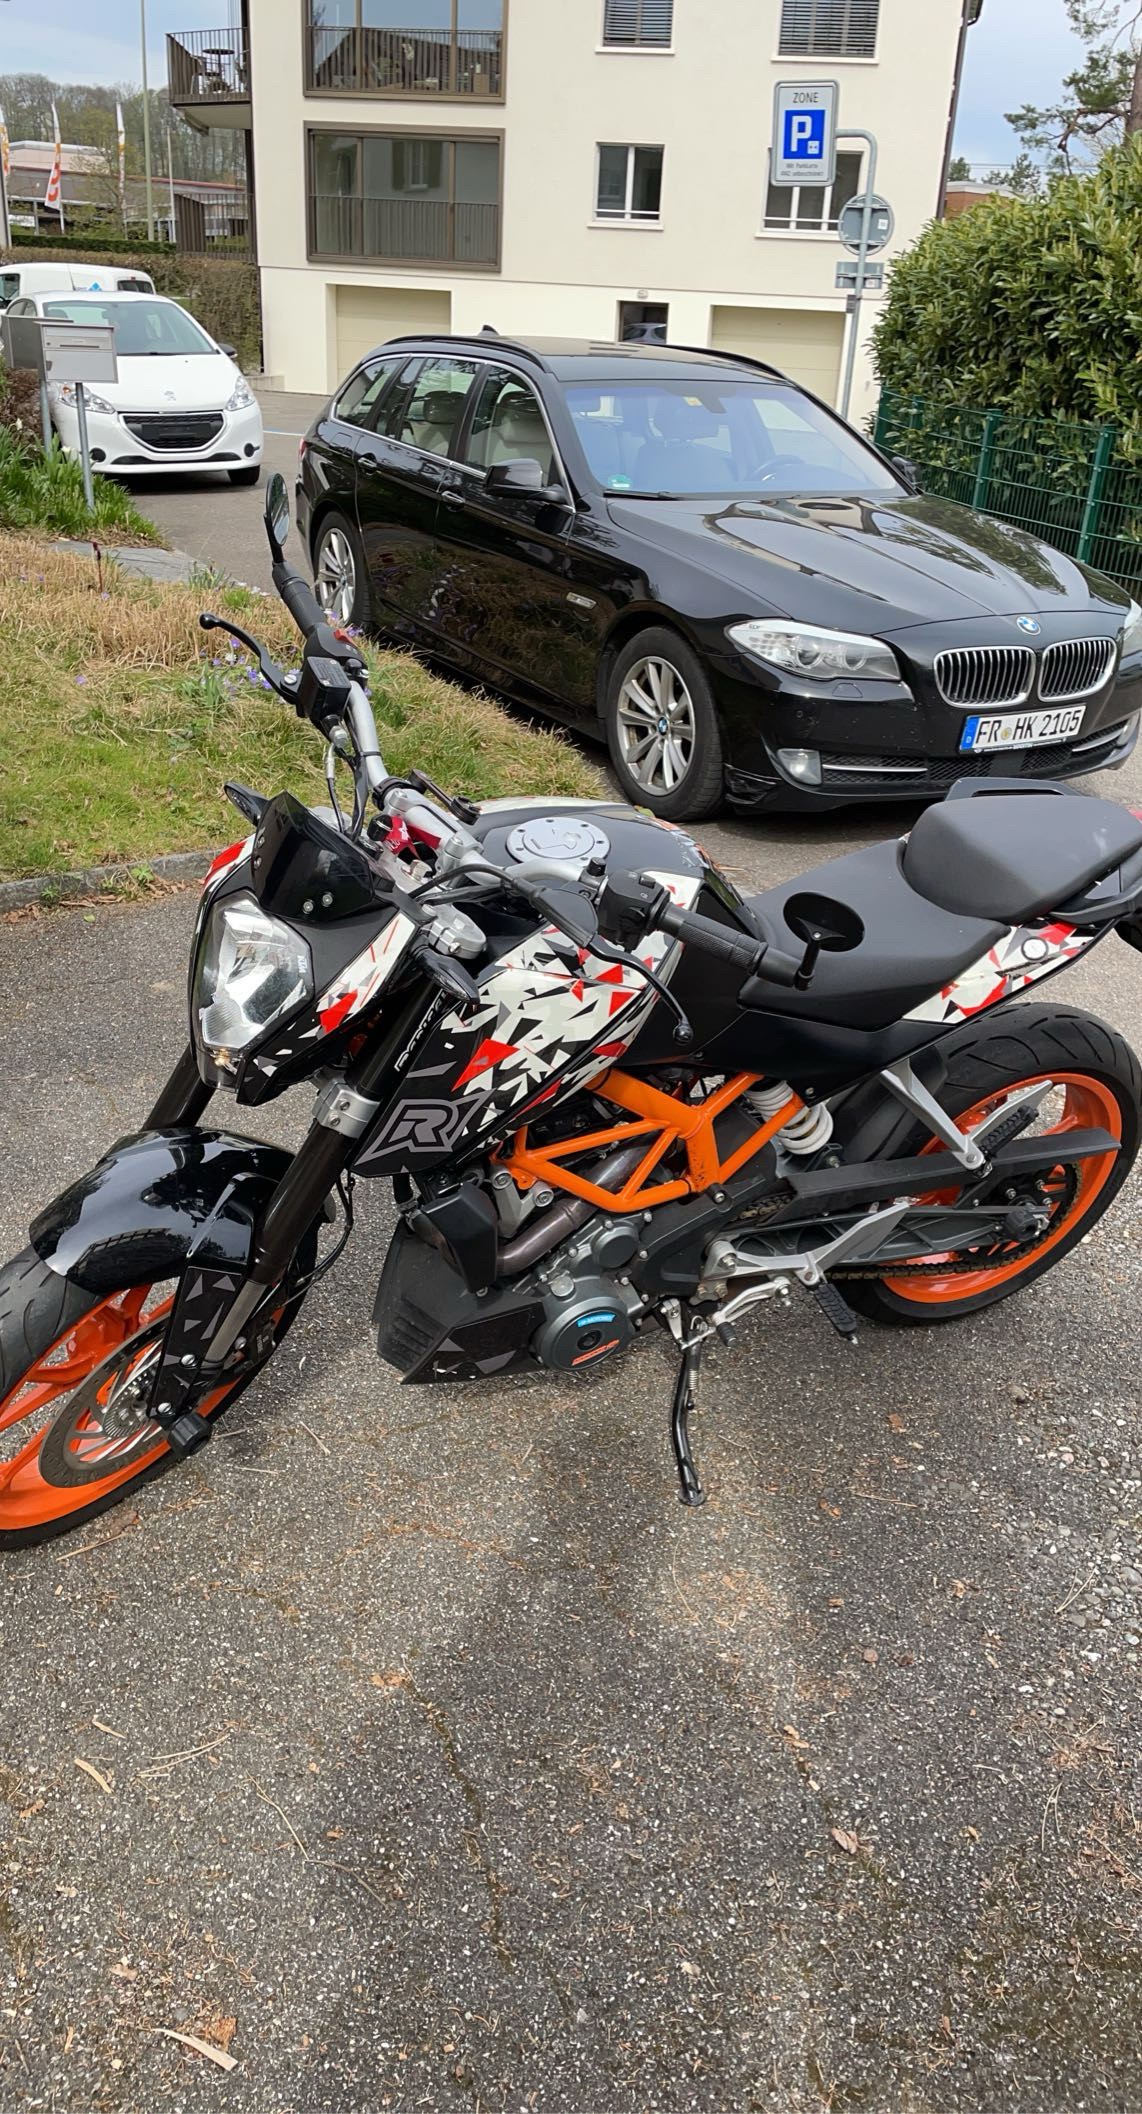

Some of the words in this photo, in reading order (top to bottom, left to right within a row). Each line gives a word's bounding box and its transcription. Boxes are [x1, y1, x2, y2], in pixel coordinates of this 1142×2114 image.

[792, 92, 819, 103] ZONE
[790, 115, 812, 152] P
[976, 720, 1002, 744] FR
[1013, 716, 1038, 740] HK
[1039, 710, 1081, 737] 2105
